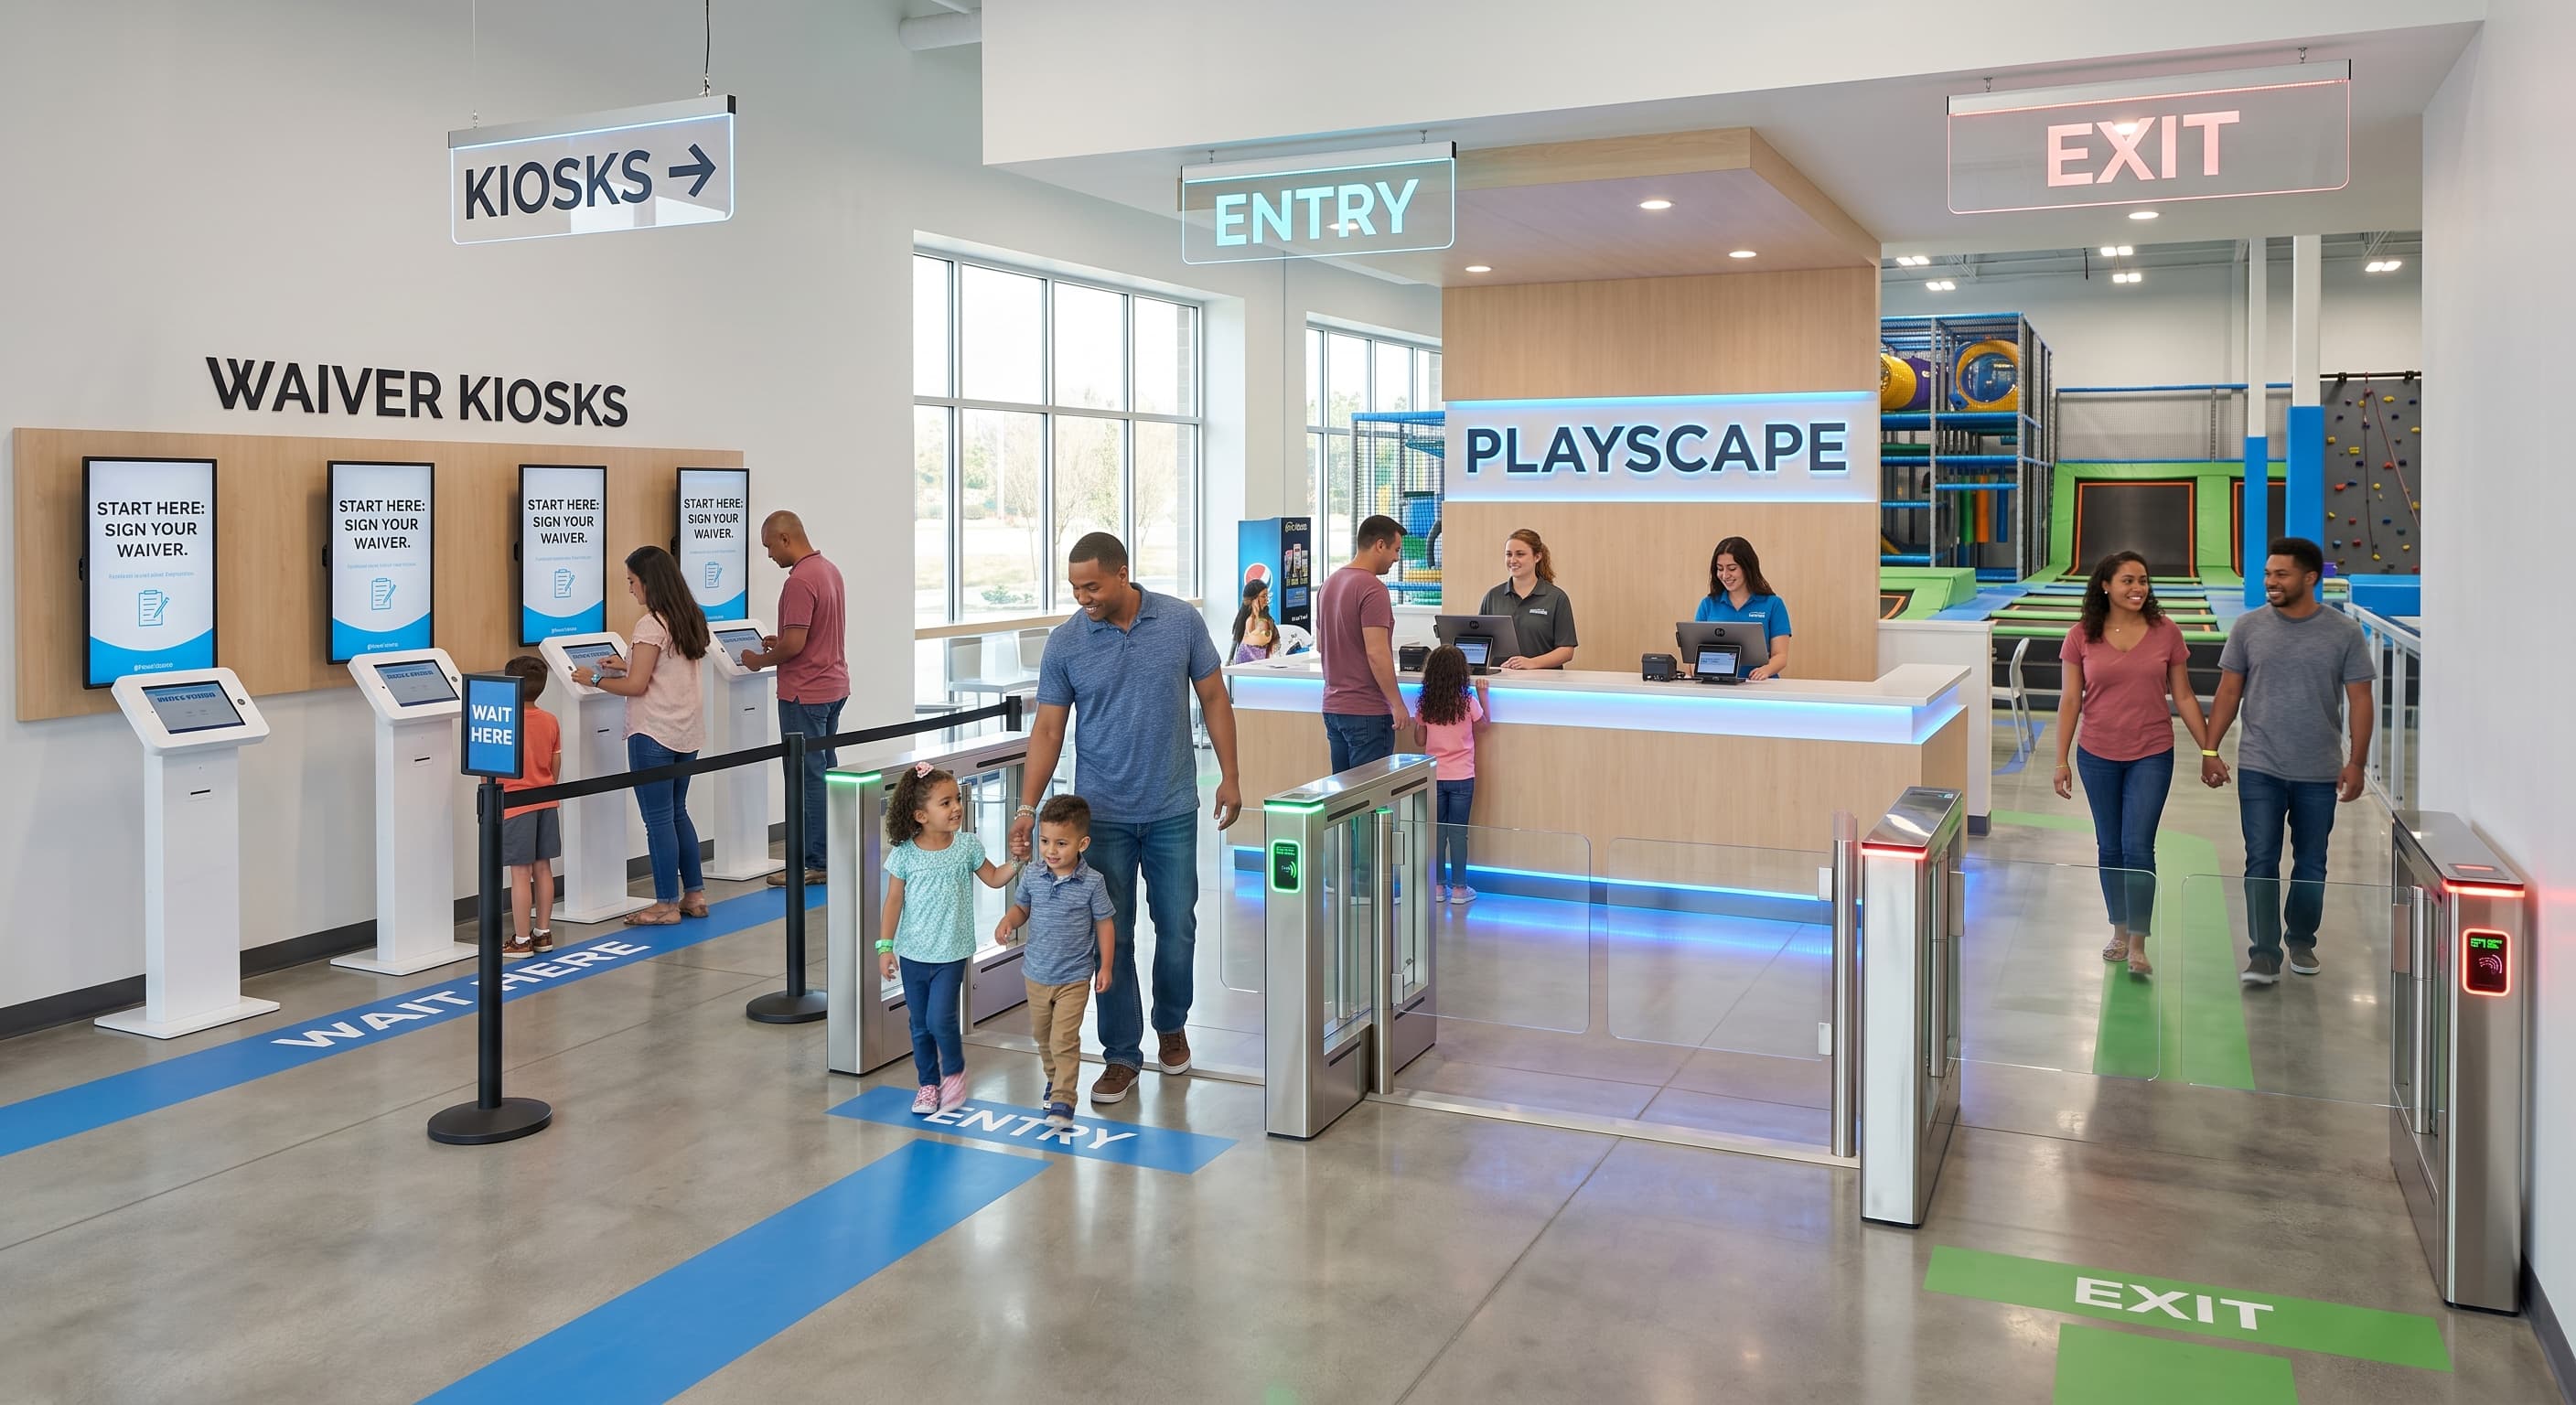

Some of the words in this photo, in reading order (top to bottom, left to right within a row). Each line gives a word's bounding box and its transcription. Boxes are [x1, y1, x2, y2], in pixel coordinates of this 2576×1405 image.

[2047, 110, 2239, 188] EXIT
[466, 149, 652, 220] KIOSKS
[1216, 178, 1419, 246] ENTRY
[206, 357, 444, 419] WAIVER
[459, 373, 628, 427] KIOSKS
[1466, 423, 1848, 473] PLAYSCAPE
[97, 502, 153, 516] START
[157, 501, 205, 515] HERE:
[339, 499, 383, 512] START
[387, 499, 425, 512] HERE:
[528, 499, 564, 510] START
[567, 499, 599, 509] HERE:
[684, 499, 714, 509] START
[716, 499, 743, 509] HERE:
[345, 519, 378, 531] SIGN
[381, 518, 418, 531] YOUR
[533, 516, 561, 528] SIGN
[564, 516, 594, 527] YOUR
[688, 514, 711, 524] SIGN
[714, 513, 738, 523] YOUR
[105, 523, 146, 537] SIGN
[151, 522, 198, 535] YOUR
[694, 528, 734, 539] WAIVER.
[354, 537, 411, 549] WAIVER.
[541, 532, 587, 544] WAIVER.
[117, 542, 188, 557] WAIVER.
[472, 704, 512, 723] WAIT
[471, 727, 512, 745] HERE
[271, 991, 474, 1048] WAIT
[470, 940, 651, 992] HERE
[2075, 1276, 2274, 1330] EXIT
